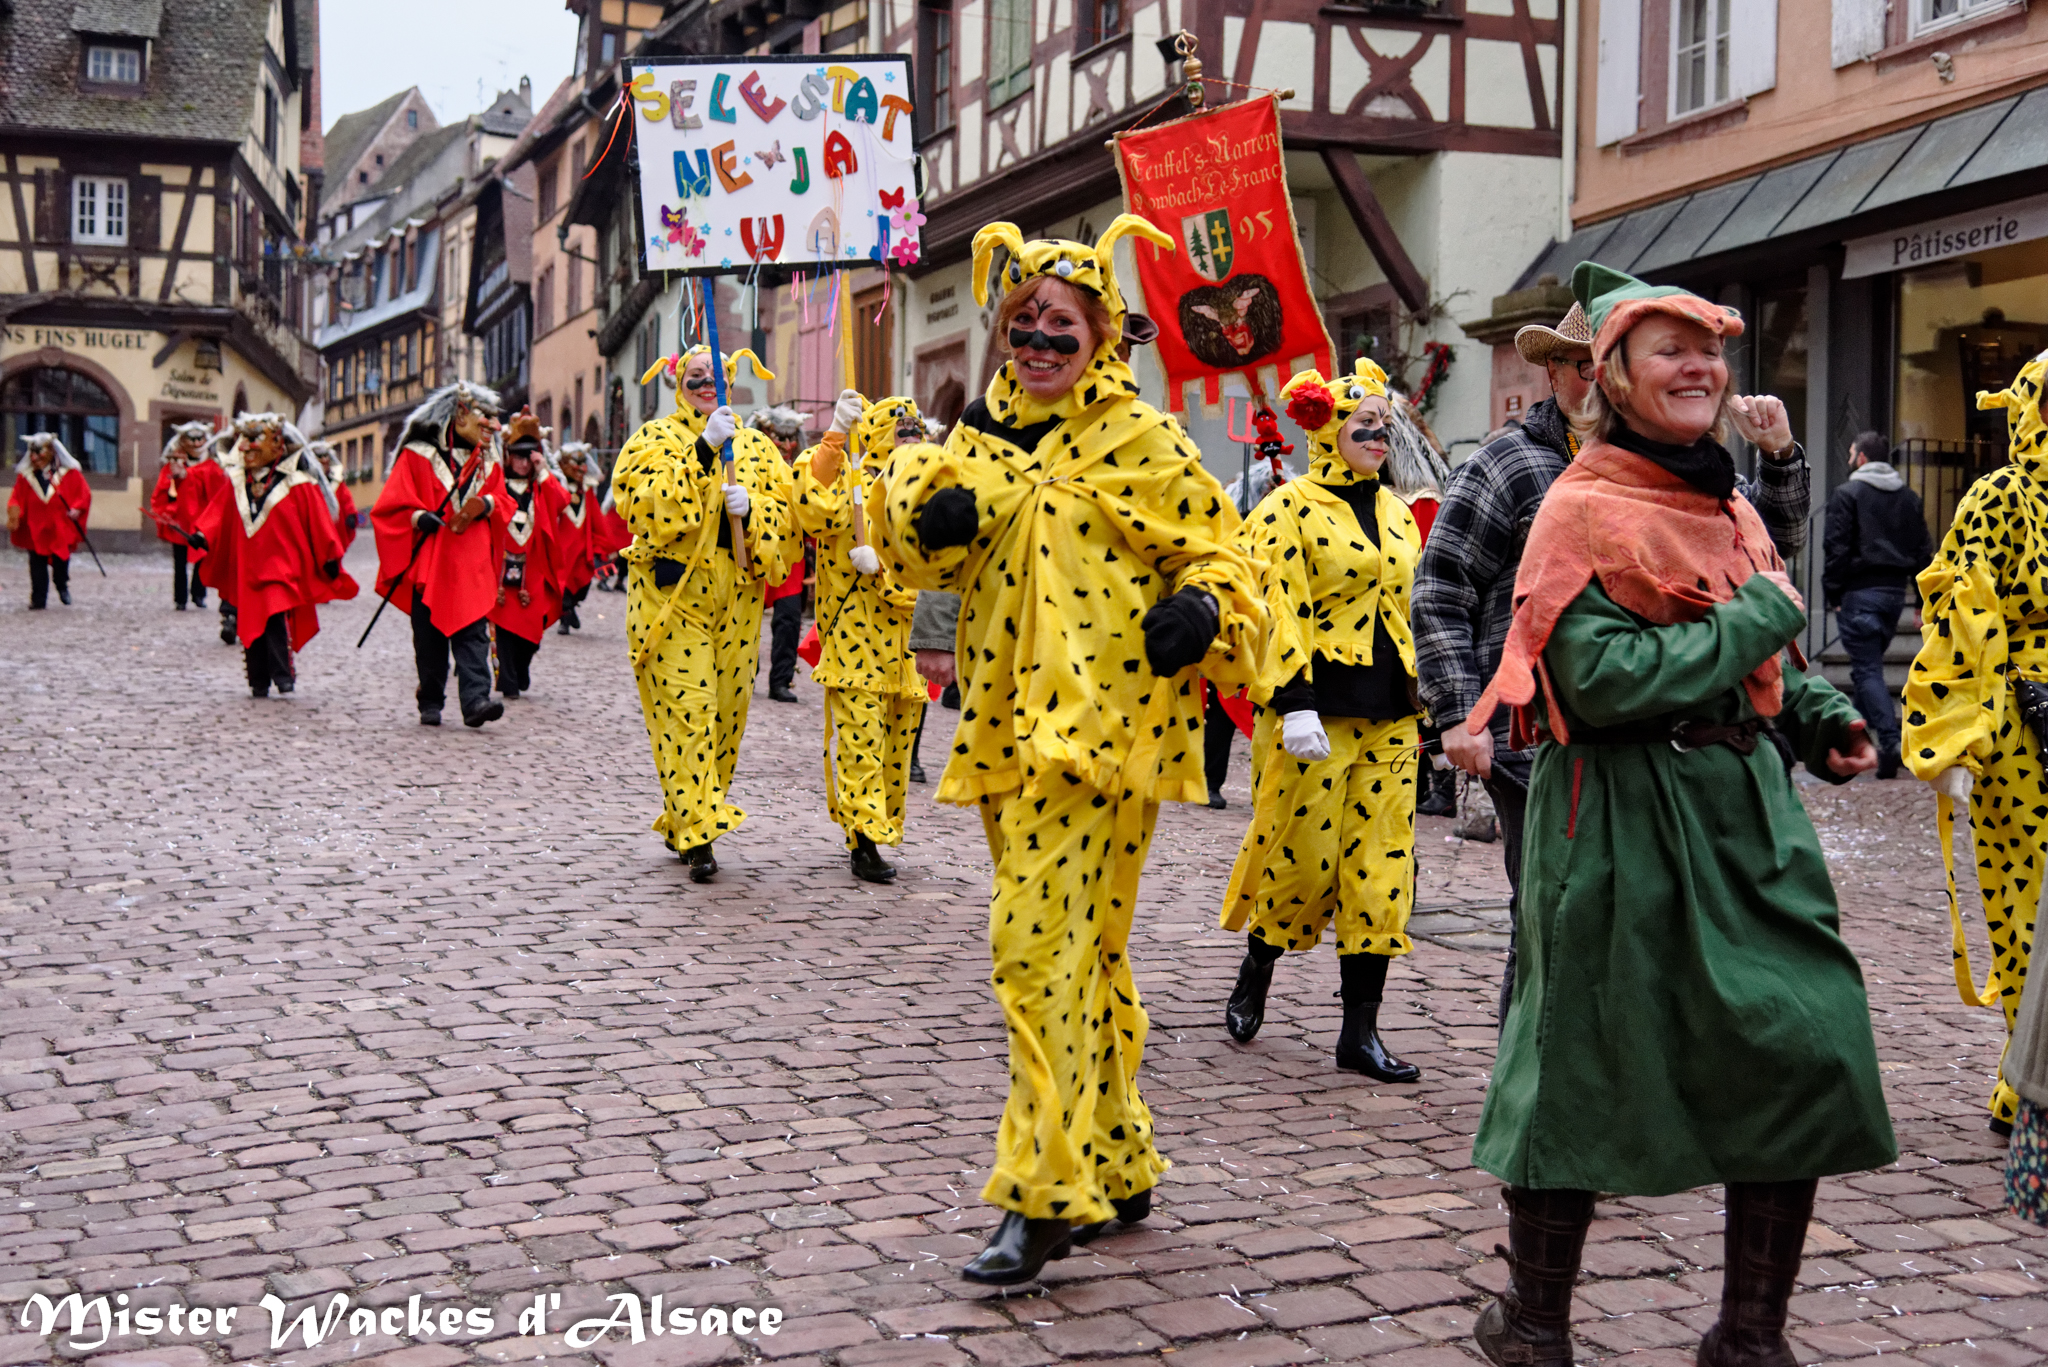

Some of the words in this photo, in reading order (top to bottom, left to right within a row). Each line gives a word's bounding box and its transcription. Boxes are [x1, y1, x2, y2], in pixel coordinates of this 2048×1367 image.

[631, 66, 913, 142] SELESTAT
[673, 139, 753, 198] NE
[790, 130, 858, 195] JA
[1240, 208, 1273, 243] 95
[1892, 216, 2019, 265] Pâtisserie
[35, 329, 76, 347] FINS
[1566, 432, 1580, 456] Nikon
